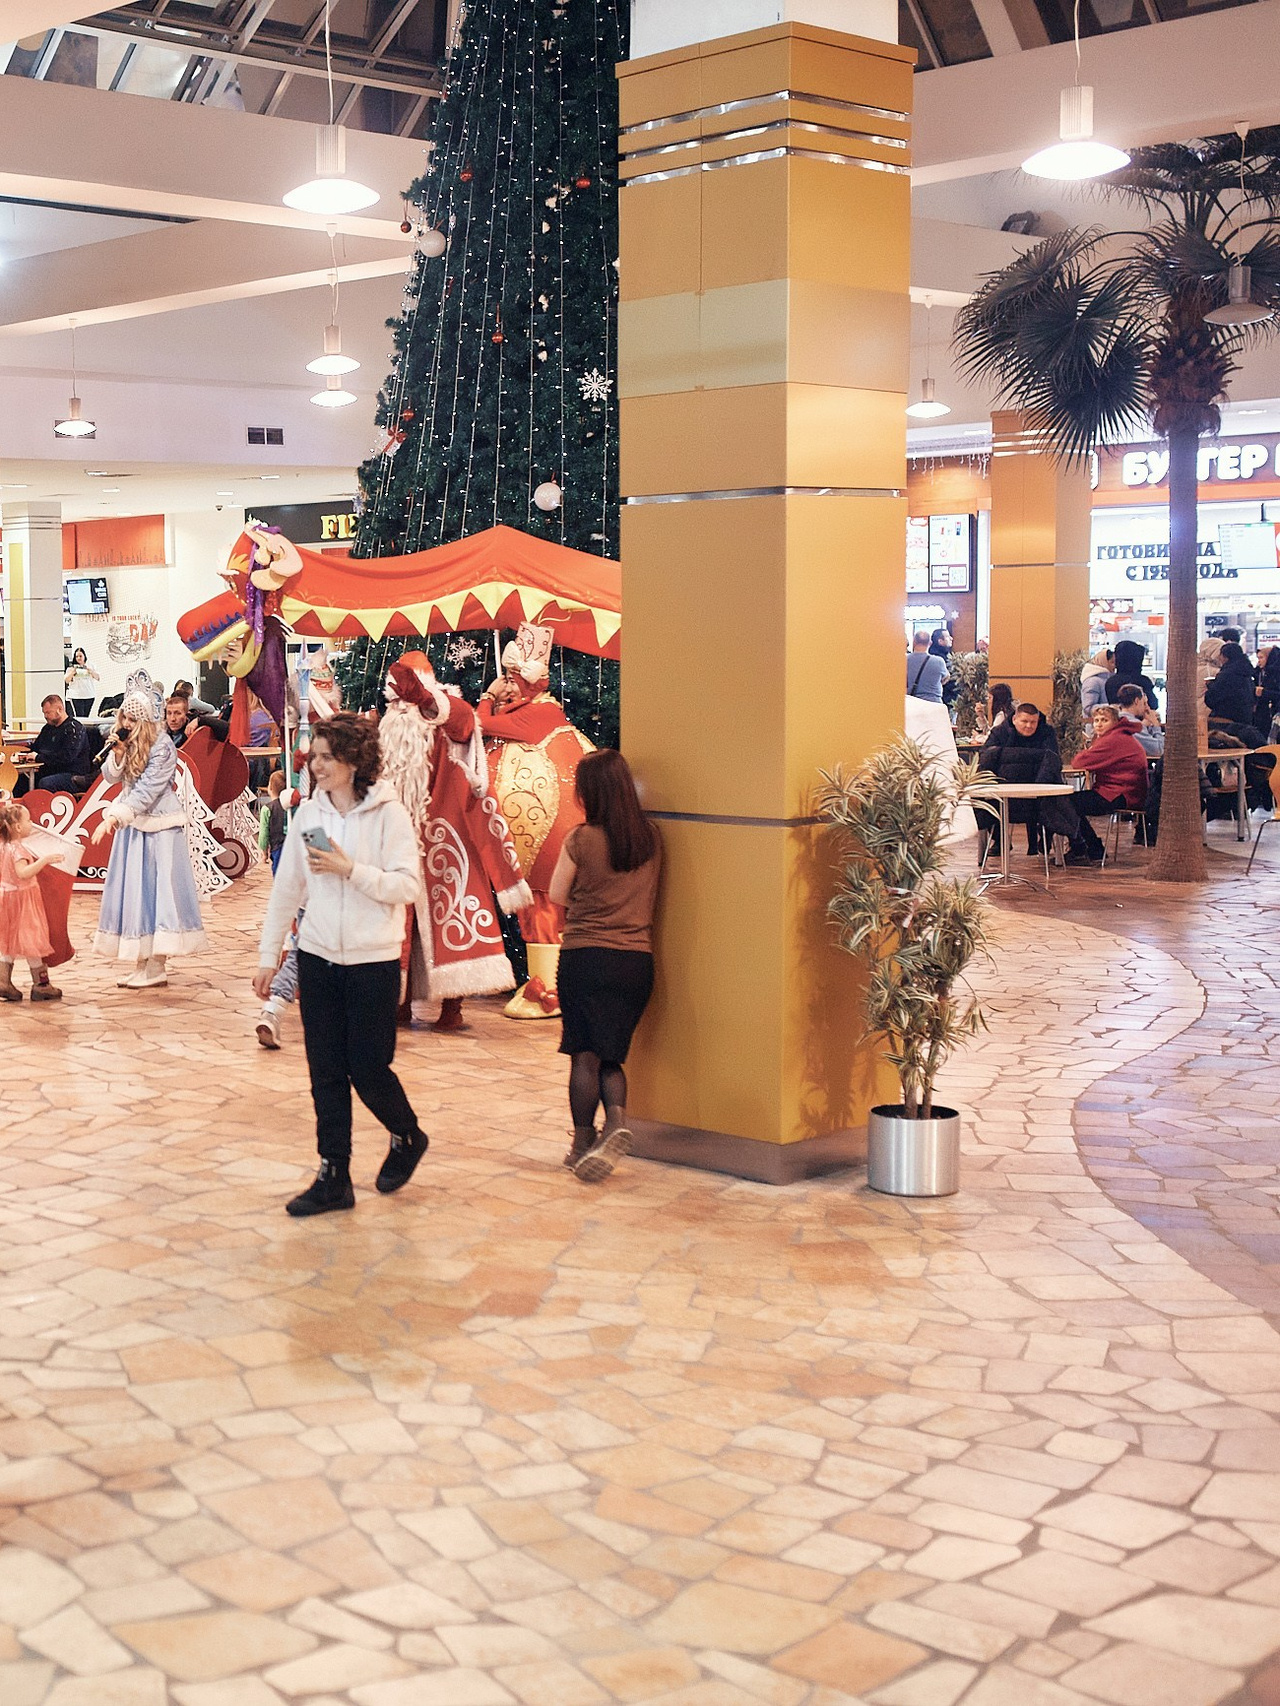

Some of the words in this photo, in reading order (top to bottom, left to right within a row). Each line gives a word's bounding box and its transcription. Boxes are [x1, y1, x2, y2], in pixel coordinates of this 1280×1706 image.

[1122, 444, 1269, 486] БУГЕР
[1097, 543, 1170, 560] ГОТОВИ
[1126, 565, 1138, 580] С
[1143, 565, 1170, 580] 195
[1196, 563, 1239, 578] ОДА
